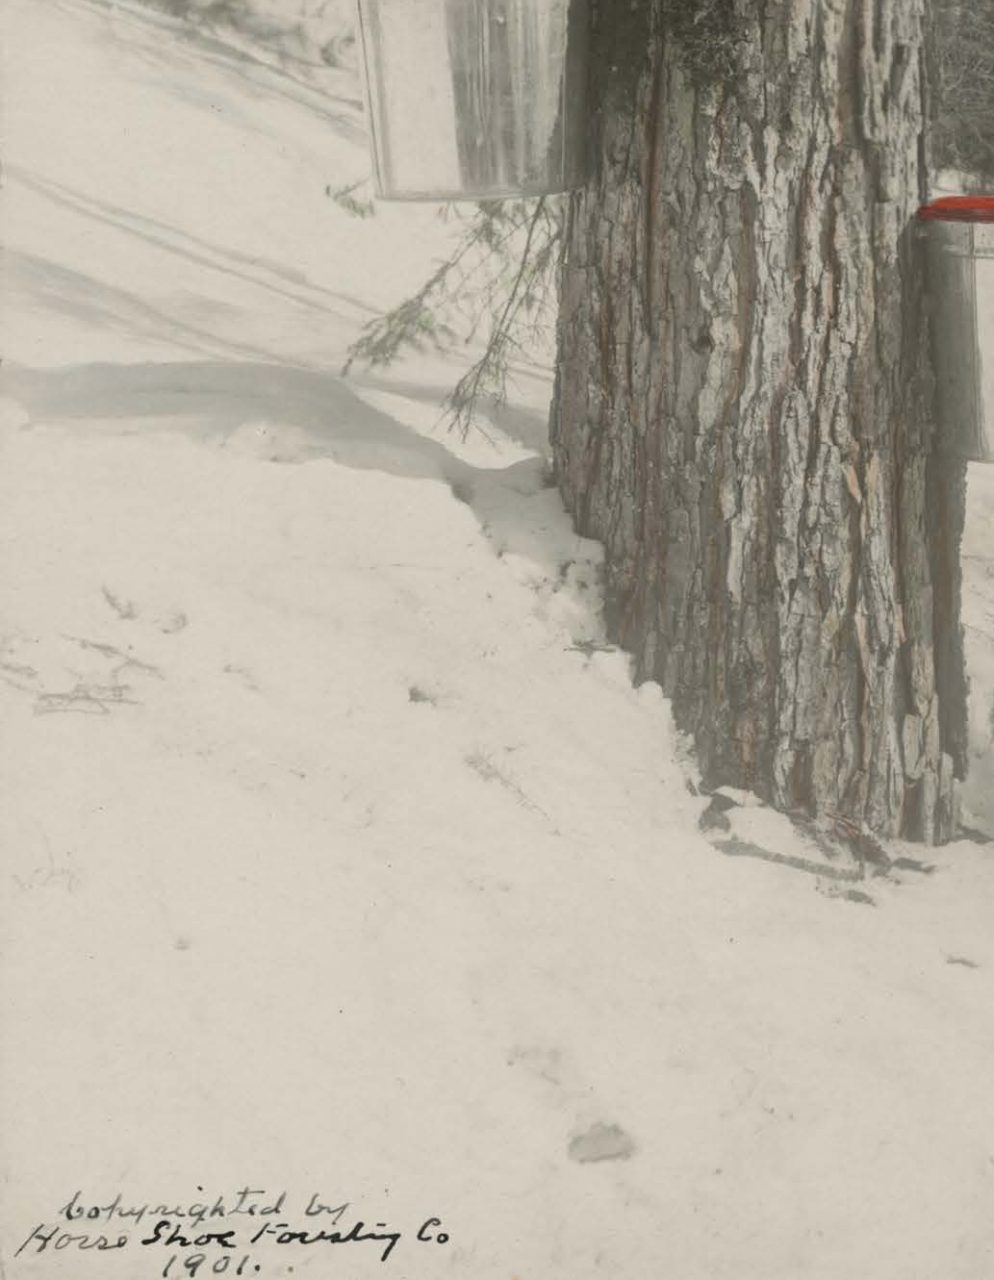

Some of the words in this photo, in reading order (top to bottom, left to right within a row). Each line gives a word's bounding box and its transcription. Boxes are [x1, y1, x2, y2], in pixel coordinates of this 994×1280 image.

[304, 1192, 351, 1226] by
[14, 1224, 130, 1258] Horse
[141, 1219, 237, 1248] Shoe
[416, 1217, 451, 1244] Co
